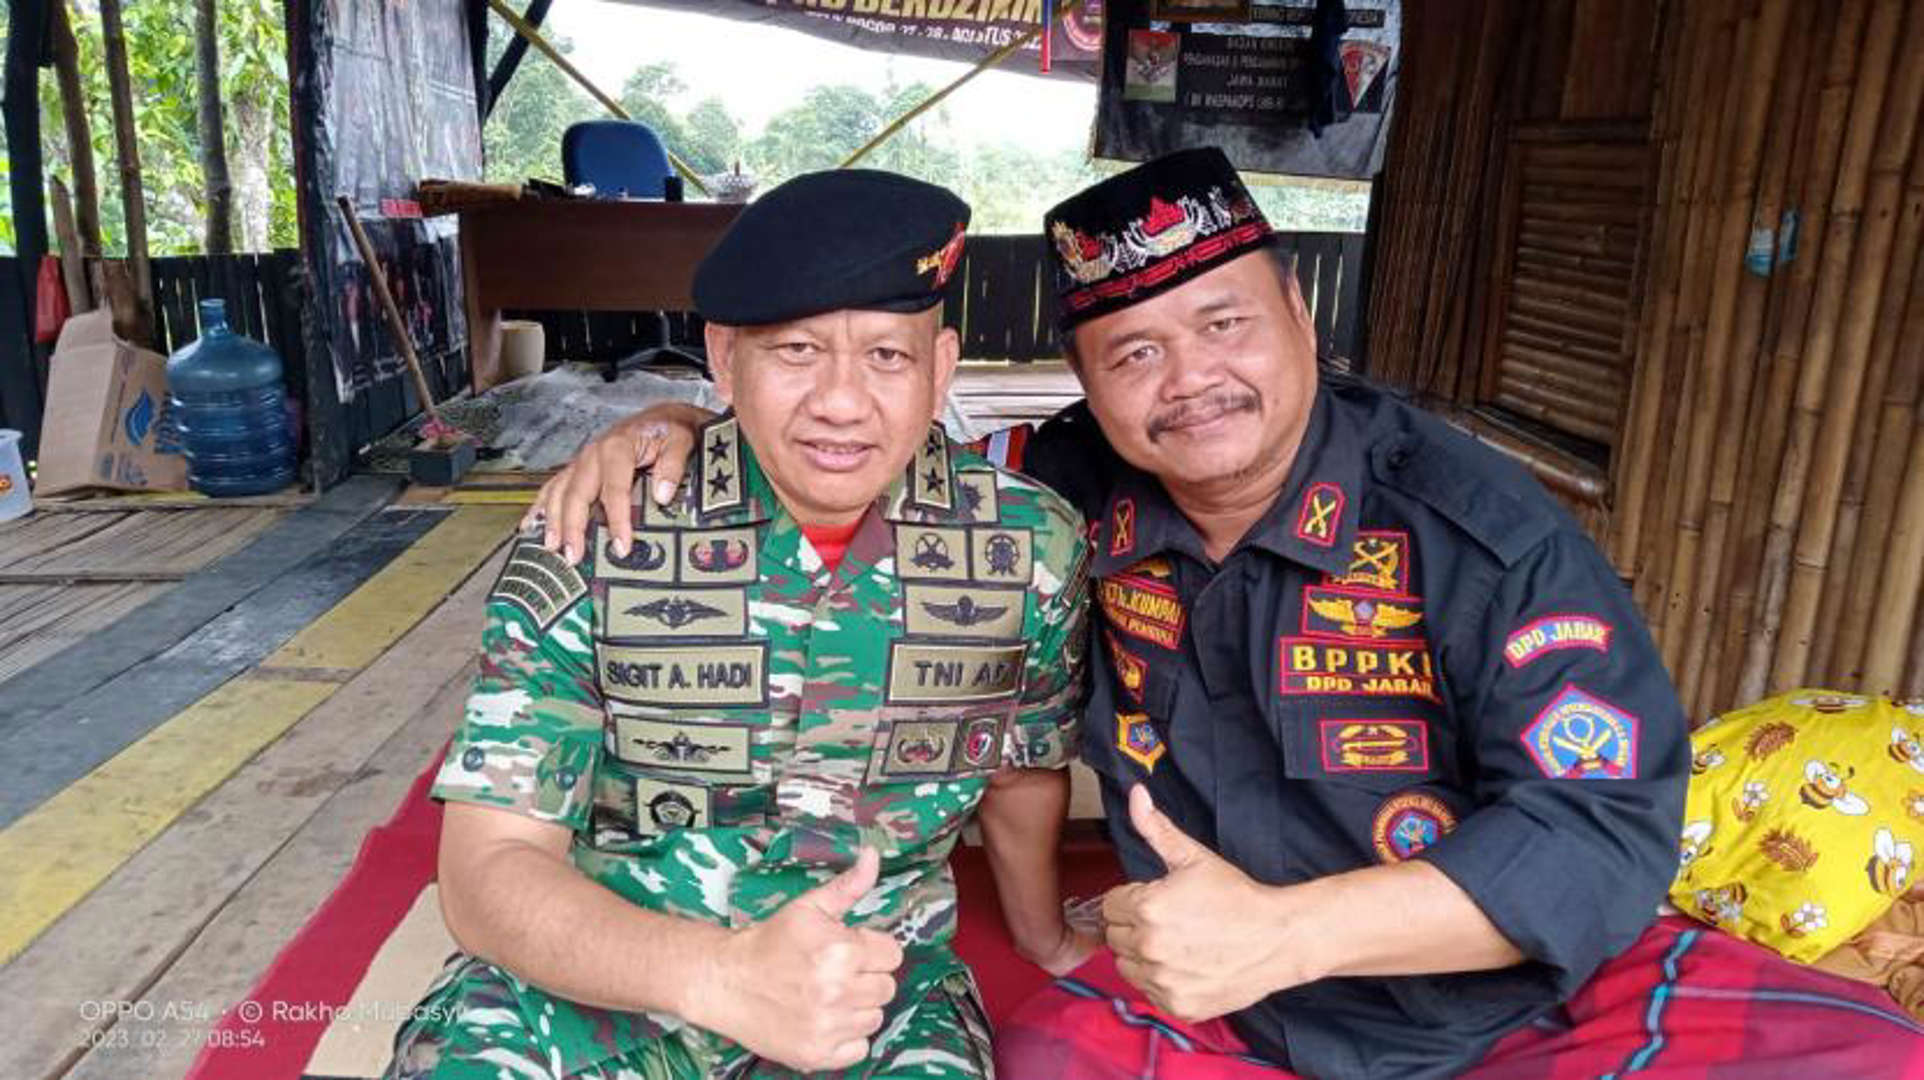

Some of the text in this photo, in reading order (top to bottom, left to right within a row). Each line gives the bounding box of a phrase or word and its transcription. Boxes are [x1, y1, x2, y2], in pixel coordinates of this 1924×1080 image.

[1506, 628, 1547, 659] DPD
[606, 660, 752, 689] SIGIT A. HADI
[914, 660, 963, 687] TNI
[1306, 676, 1433, 696] DPD JABAR
